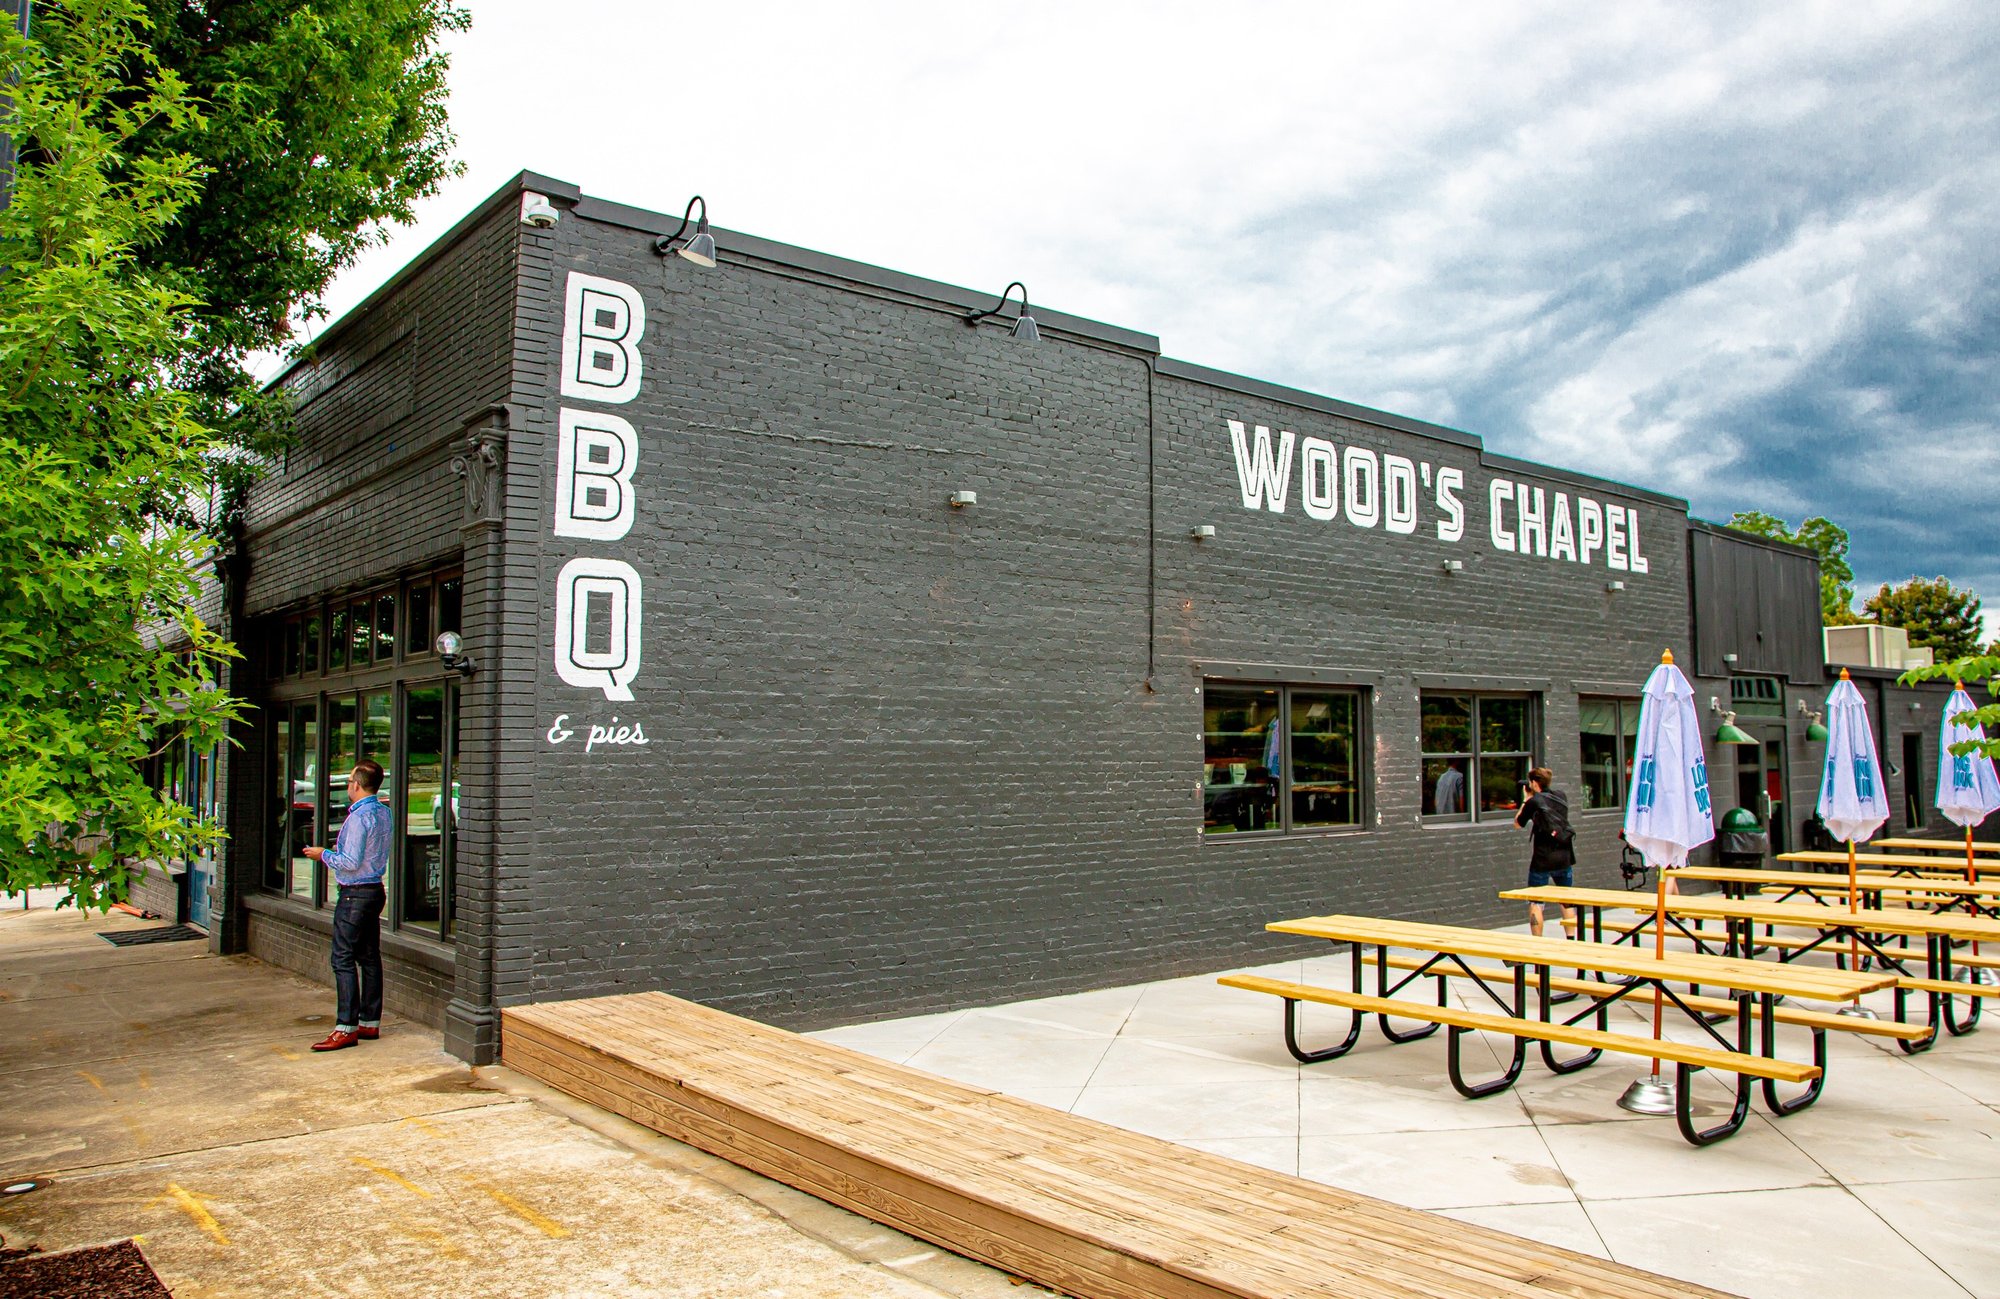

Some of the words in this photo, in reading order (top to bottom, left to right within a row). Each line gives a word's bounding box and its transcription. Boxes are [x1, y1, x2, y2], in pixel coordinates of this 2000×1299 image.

[554, 270, 646, 701] BBQ
[1227, 419, 1464, 542] WOOD'S
[1489, 478, 1649, 573] CHAPEL
[546, 714, 574, 745] &
[585, 717, 650, 753] pies
[1691, 763, 1707, 789] LO
[1694, 786, 1710, 812] DR
